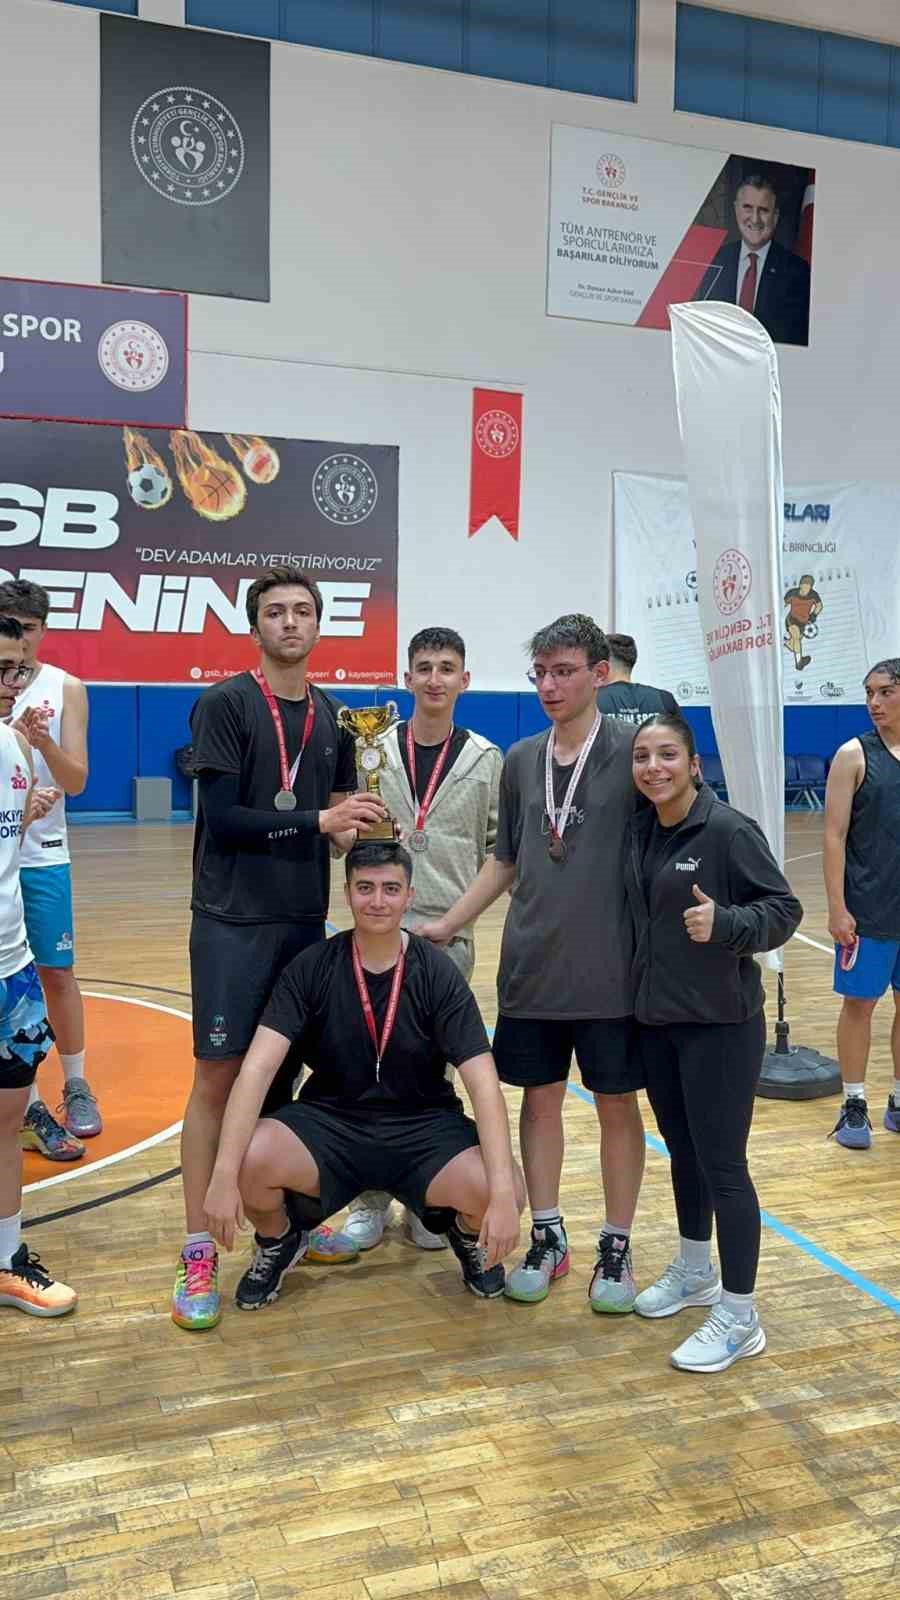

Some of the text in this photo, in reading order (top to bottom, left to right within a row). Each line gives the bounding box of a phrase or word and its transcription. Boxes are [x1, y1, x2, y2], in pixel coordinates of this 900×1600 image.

[559, 220, 657, 247] TÜM ANTRENÖR VE
[562, 234, 654, 258] SPORCULARIMIZA
[557, 247, 659, 270] BAŞARILAR DİLİYORUM
[2, 312, 82, 344] SPOR
[784, 502, 830, 524] RLARI
[177, 550, 257, 567] ADAMLAR
[675, 862, 696, 871] PUMA
